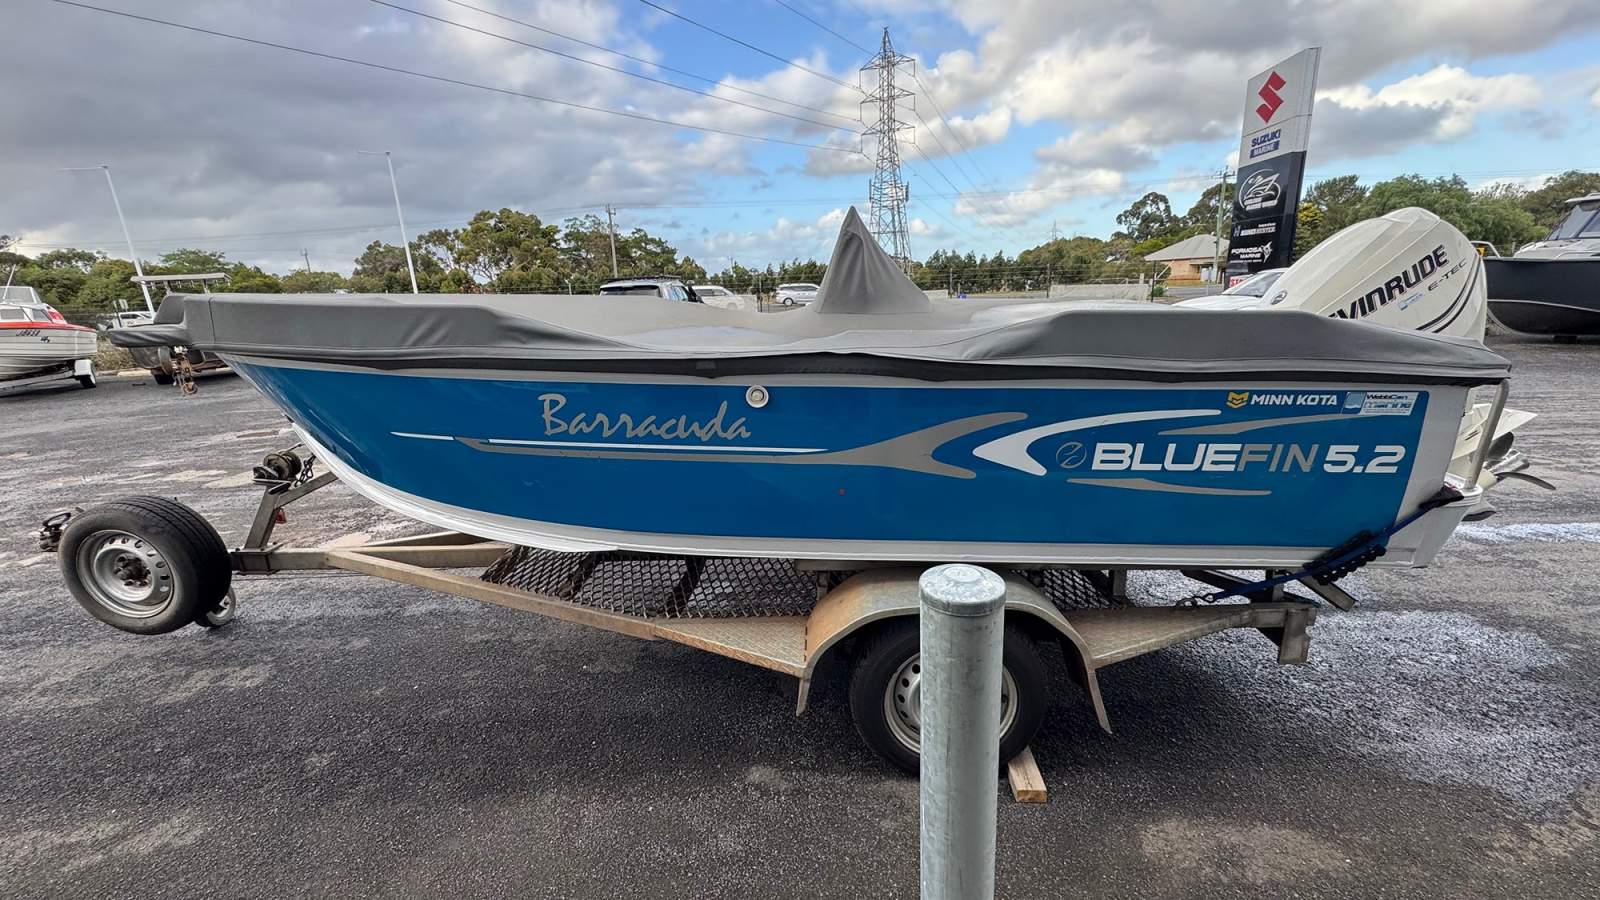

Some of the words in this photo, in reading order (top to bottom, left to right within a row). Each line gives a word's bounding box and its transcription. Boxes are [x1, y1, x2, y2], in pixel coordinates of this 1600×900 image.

[1251, 129, 1282, 148] SUZUKI
[1253, 142, 1275, 156] MARINE
[1329, 244, 1449, 319] VINRUDE
[1250, 394, 1295, 406] MINN
[1296, 394, 1338, 406] KOTA
[538, 393, 751, 441] Barracuda
[1092, 443, 1319, 473] BLUEFIN
[1323, 445, 1406, 473] 5.2
